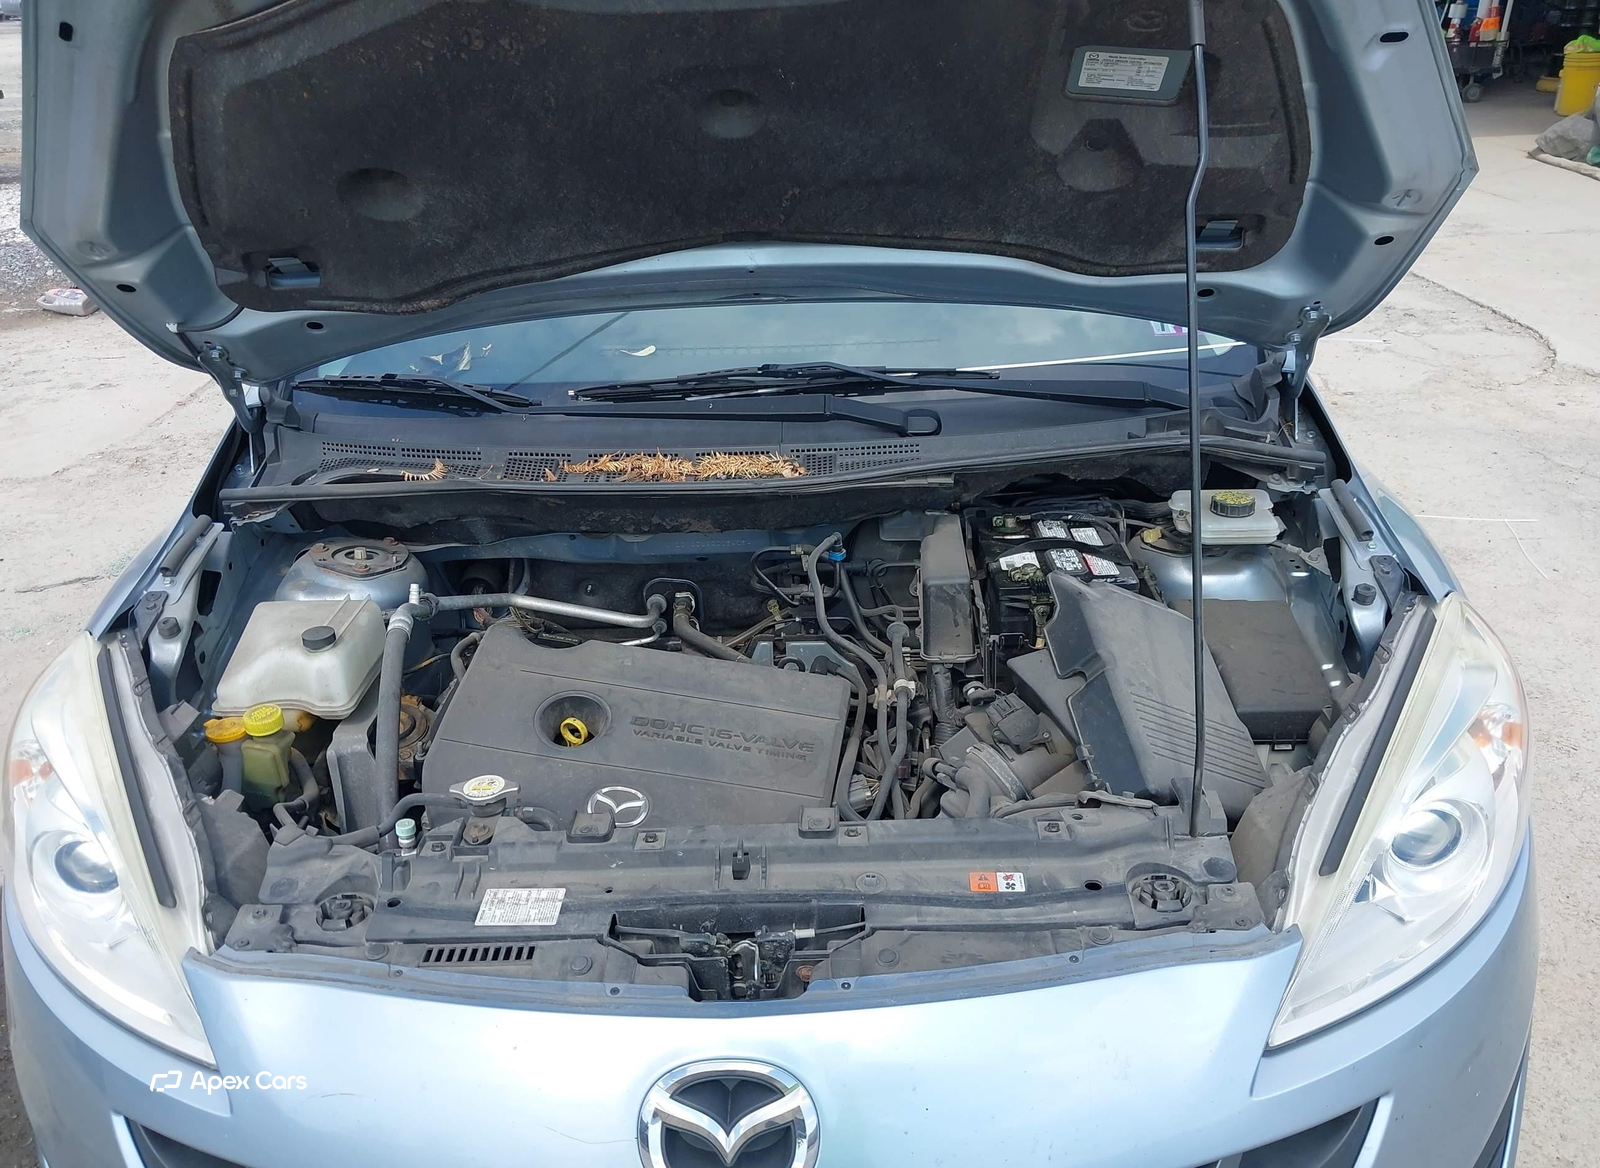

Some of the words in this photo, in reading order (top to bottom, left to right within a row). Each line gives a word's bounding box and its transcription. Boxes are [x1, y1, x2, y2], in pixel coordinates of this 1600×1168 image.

[629, 716, 704, 735] DOHC
[709, 726, 815, 753] 16-VALVE
[633, 729, 703, 746] VARIABLE
[708, 740, 752, 753] VALVE
[757, 748, 807, 761] TIMING
